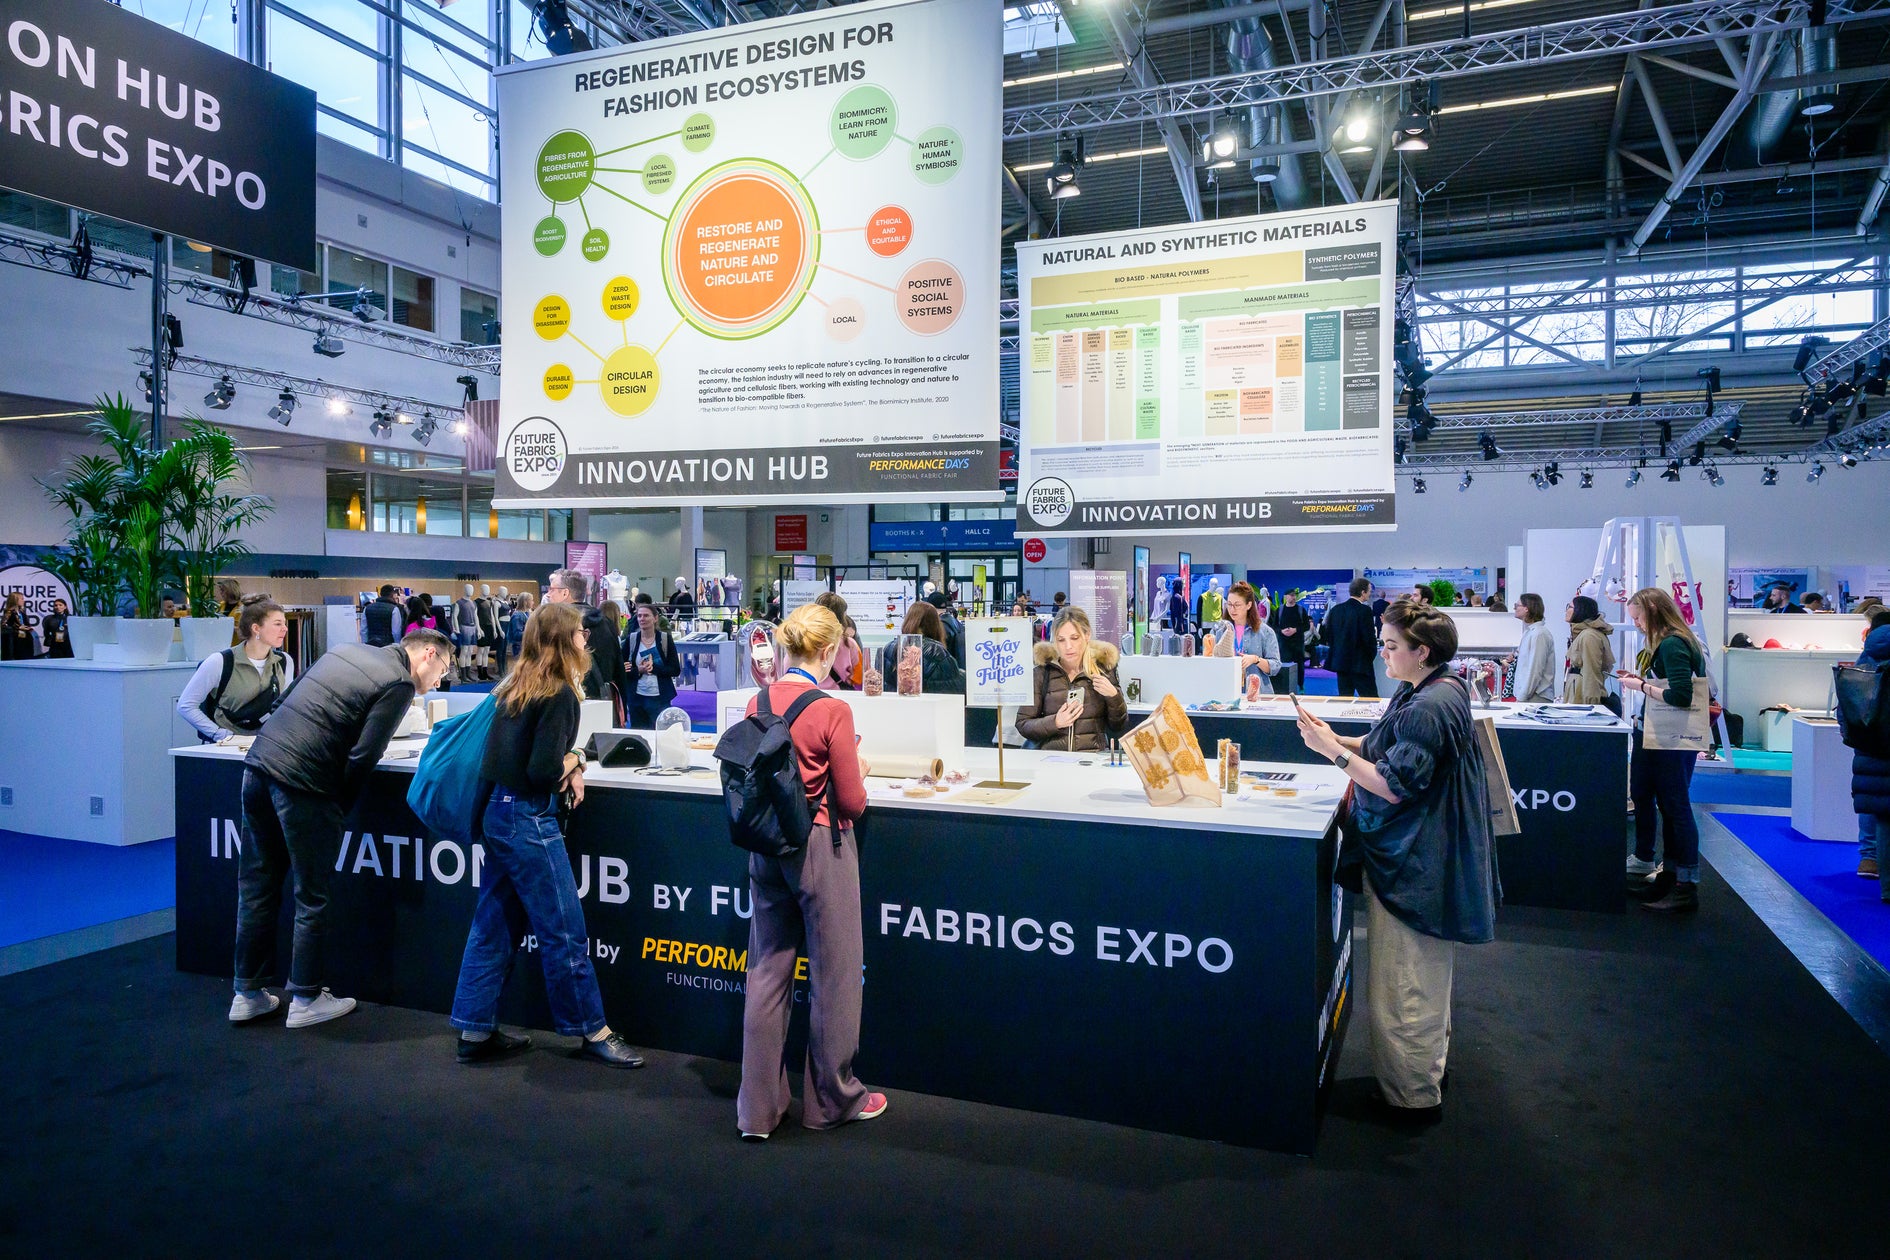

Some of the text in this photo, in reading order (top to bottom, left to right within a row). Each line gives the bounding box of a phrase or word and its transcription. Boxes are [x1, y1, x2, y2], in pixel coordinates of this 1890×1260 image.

[575, 22, 894, 93] REGENERATIVE DESIGN FOR
[8, 20, 221, 132] ON HUB
[603, 59, 866, 118] FASHION ECOSYSTEMS
[838, 107, 888, 120] BIOMIMICRY:
[686, 124, 710, 132] CLIMATE
[838, 116, 888, 130] LEARN FROM
[686, 132, 710, 140] FARMING
[848, 128, 878, 140] NATURE
[0, 90, 266, 210] RICS EXPO
[918, 140, 948, 151] NATURE
[544, 150, 586, 162] FIBRES FROM
[922, 148, 952, 160] HUMAN
[542, 160, 590, 172] REGENERATIVE
[915, 158, 958, 171] SYMBIOSIS
[544, 171, 587, 182] AGRICULTURE
[646, 170, 672, 178] FIBRESHED
[648, 178, 670, 186] SYSTEMS
[696, 218, 784, 240] RESTORE AND
[876, 218, 902, 228] ETHICAL
[882, 226, 896, 234] AND
[700, 237, 780, 255] REGENERATE
[872, 235, 906, 246] EQUITABLE
[1042, 218, 1367, 266] NATURAL AND SYNTHETIC MATERIALS
[700, 253, 778, 272] NATURE AND
[1308, 251, 1378, 264] SYNTHETIC POLYMERS
[704, 270, 774, 288] CIRCULATE
[1126, 274, 1145, 282] BASED
[1150, 271, 1177, 280] NATURAL
[1179, 268, 1210, 278] POLYMERS
[908, 278, 952, 290] POSITIVE
[912, 292, 948, 304] SOCIAL
[1244, 292, 1309, 303] MANMADE MATERIALS
[907, 306, 952, 318] SYSTEMS
[1090, 309, 1119, 317] MATERIALS
[536, 320, 568, 328] DISASSEMBLY
[832, 315, 857, 325] LOCAL
[736, 366, 766, 374] economy
[796, 361, 825, 371] replicate
[827, 360, 854, 368] nature's
[855, 358, 883, 367] cycling.
[894, 356, 925, 364] transition
[942, 353, 970, 361] circular
[607, 371, 653, 381] CIRCULAR
[767, 373, 793, 381] industry
[833, 370, 846, 378] rely
[858, 368, 893, 376] advances
[902, 365, 948, 375] regenerative
[613, 386, 646, 394] DESIGN
[698, 386, 732, 395] agriculture
[747, 384, 777, 392] cellulosic
[799, 381, 826, 390] working
[842, 378, 868, 388] existing
[870, 377, 909, 386] technology
[735, 393, 785, 402] bio-compatible
[514, 433, 556, 444] FUTURE
[514, 445, 556, 456] FABRICS
[514, 457, 558, 472] EXPO
[578, 455, 829, 486] INNOVATION HUB
[870, 458, 969, 471] PERFORMANCEDAYS
[1033, 504, 1067, 514] EXPO
[1082, 502, 1272, 523] INNOVATION HUB
[1302, 504, 1374, 513] PERFORMANCEDAYS
[975, 639, 1021, 660] Sway
[992, 654, 1014, 670] the
[976, 664, 1024, 686] Future
[1510, 789, 1577, 812] XPO
[577, 854, 630, 904] UB
[654, 884, 692, 912] BY
[880, 902, 1075, 956] FABRICS
[1096, 925, 1234, 974] EXPO
[596, 939, 620, 964] by
